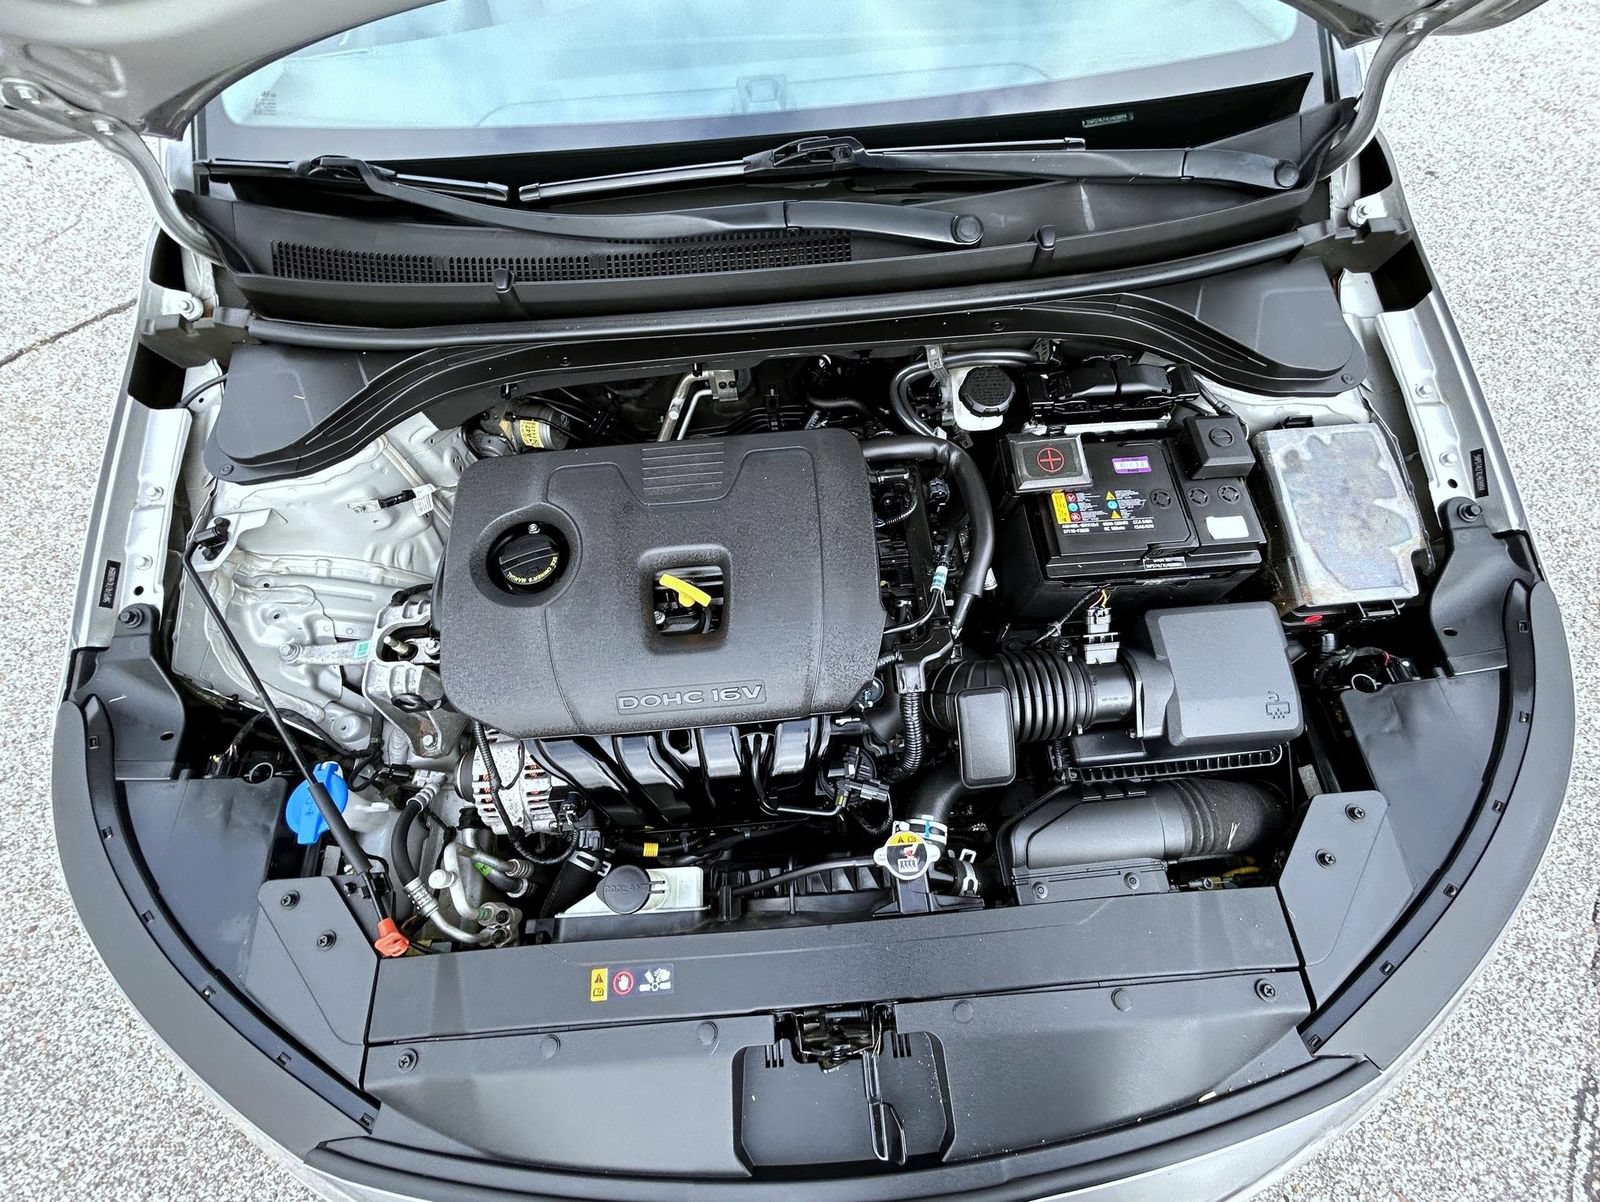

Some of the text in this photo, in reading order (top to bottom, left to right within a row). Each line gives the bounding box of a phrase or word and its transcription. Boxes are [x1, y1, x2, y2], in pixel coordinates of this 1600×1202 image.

[506, 556, 558, 583] SEE OWNER'S MANUAL
[618, 684, 762, 710] DOHC 16V
